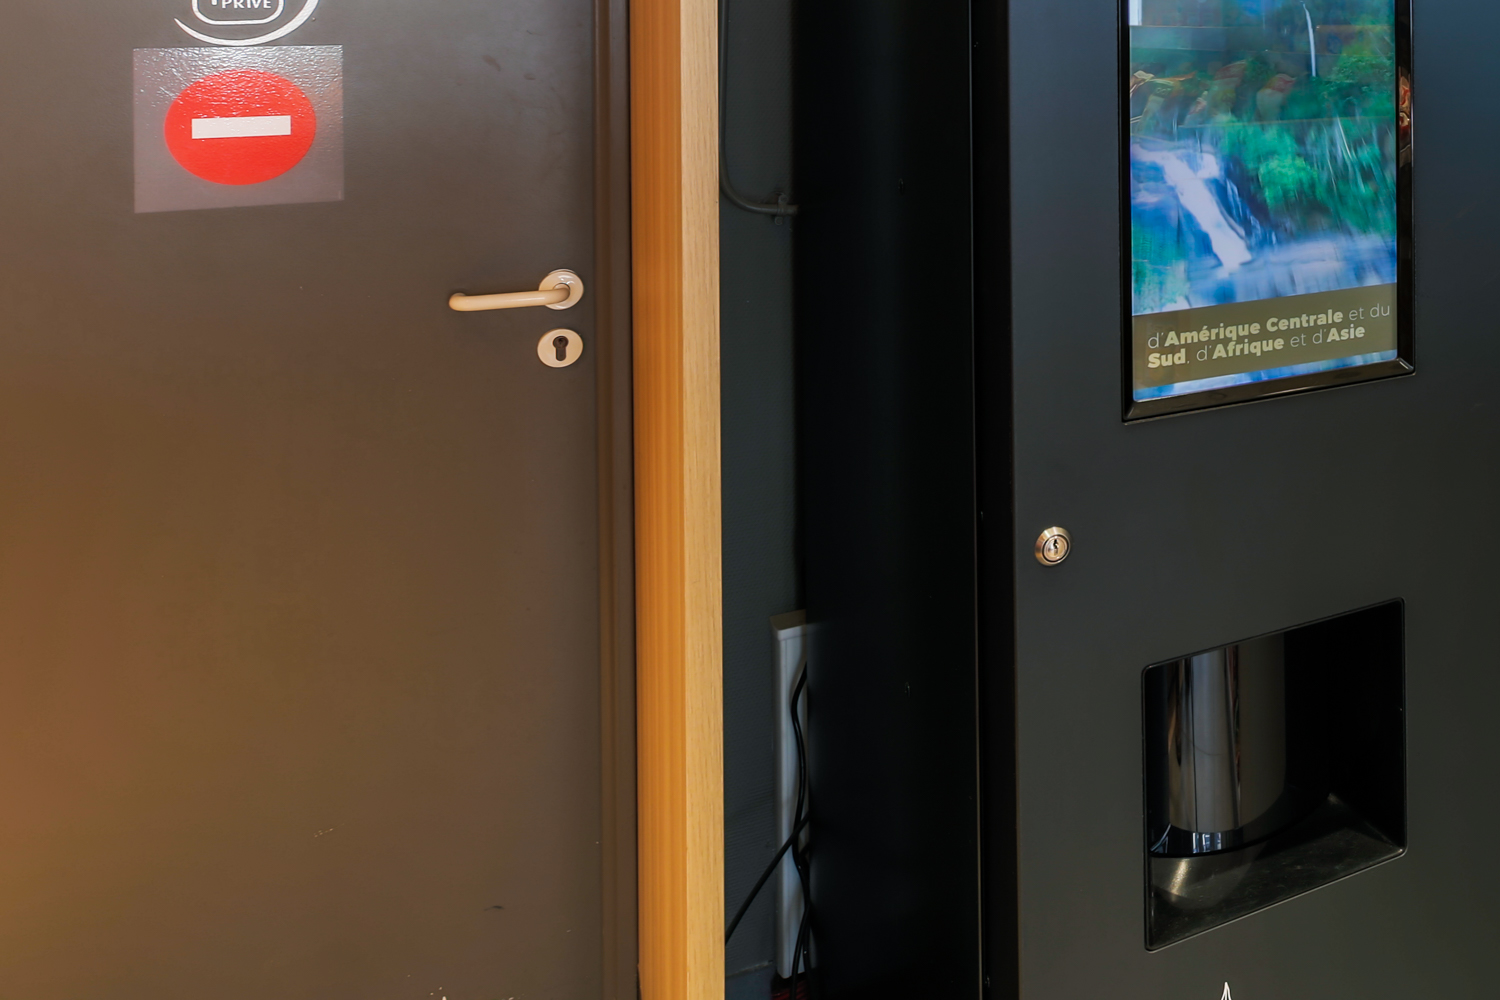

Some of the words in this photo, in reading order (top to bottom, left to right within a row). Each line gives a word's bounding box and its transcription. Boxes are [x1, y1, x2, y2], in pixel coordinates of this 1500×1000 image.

[1148, 322, 1261, 349] d'Amérique
[1266, 310, 1344, 332] Centrale
[1348, 307, 1365, 321] et
[1370, 303, 1391, 318] du
[1148, 351, 1190, 369] Sud,
[1196, 335, 1285, 362] d'Afrique
[1290, 334, 1307, 348] et
[1312, 324, 1366, 345] d'Asie
